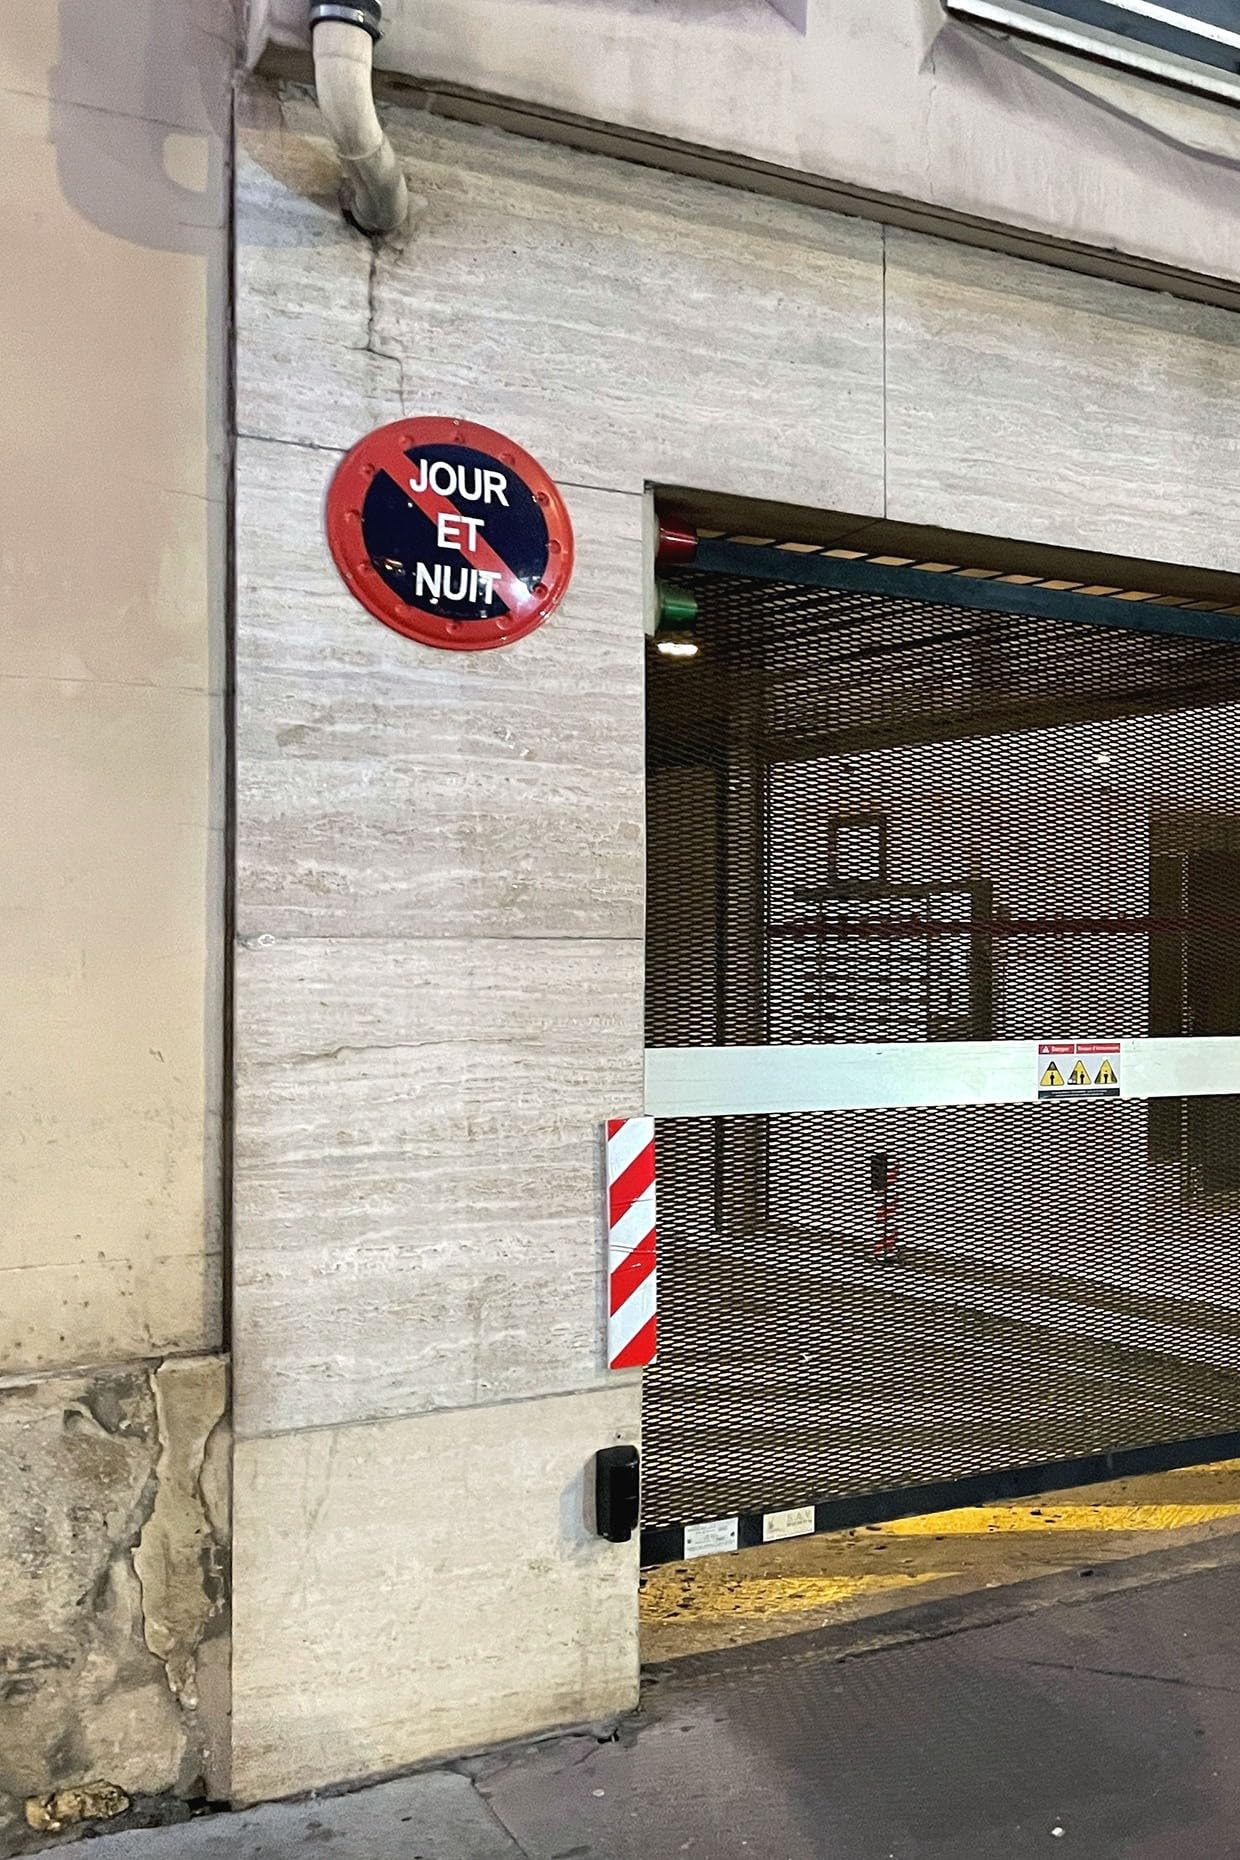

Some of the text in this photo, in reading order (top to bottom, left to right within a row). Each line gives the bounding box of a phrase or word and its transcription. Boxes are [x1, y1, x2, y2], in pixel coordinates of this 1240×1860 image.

[409, 458, 510, 507] JOUR
[437, 512, 485, 552] ET
[415, 561, 501, 605] NUIT
